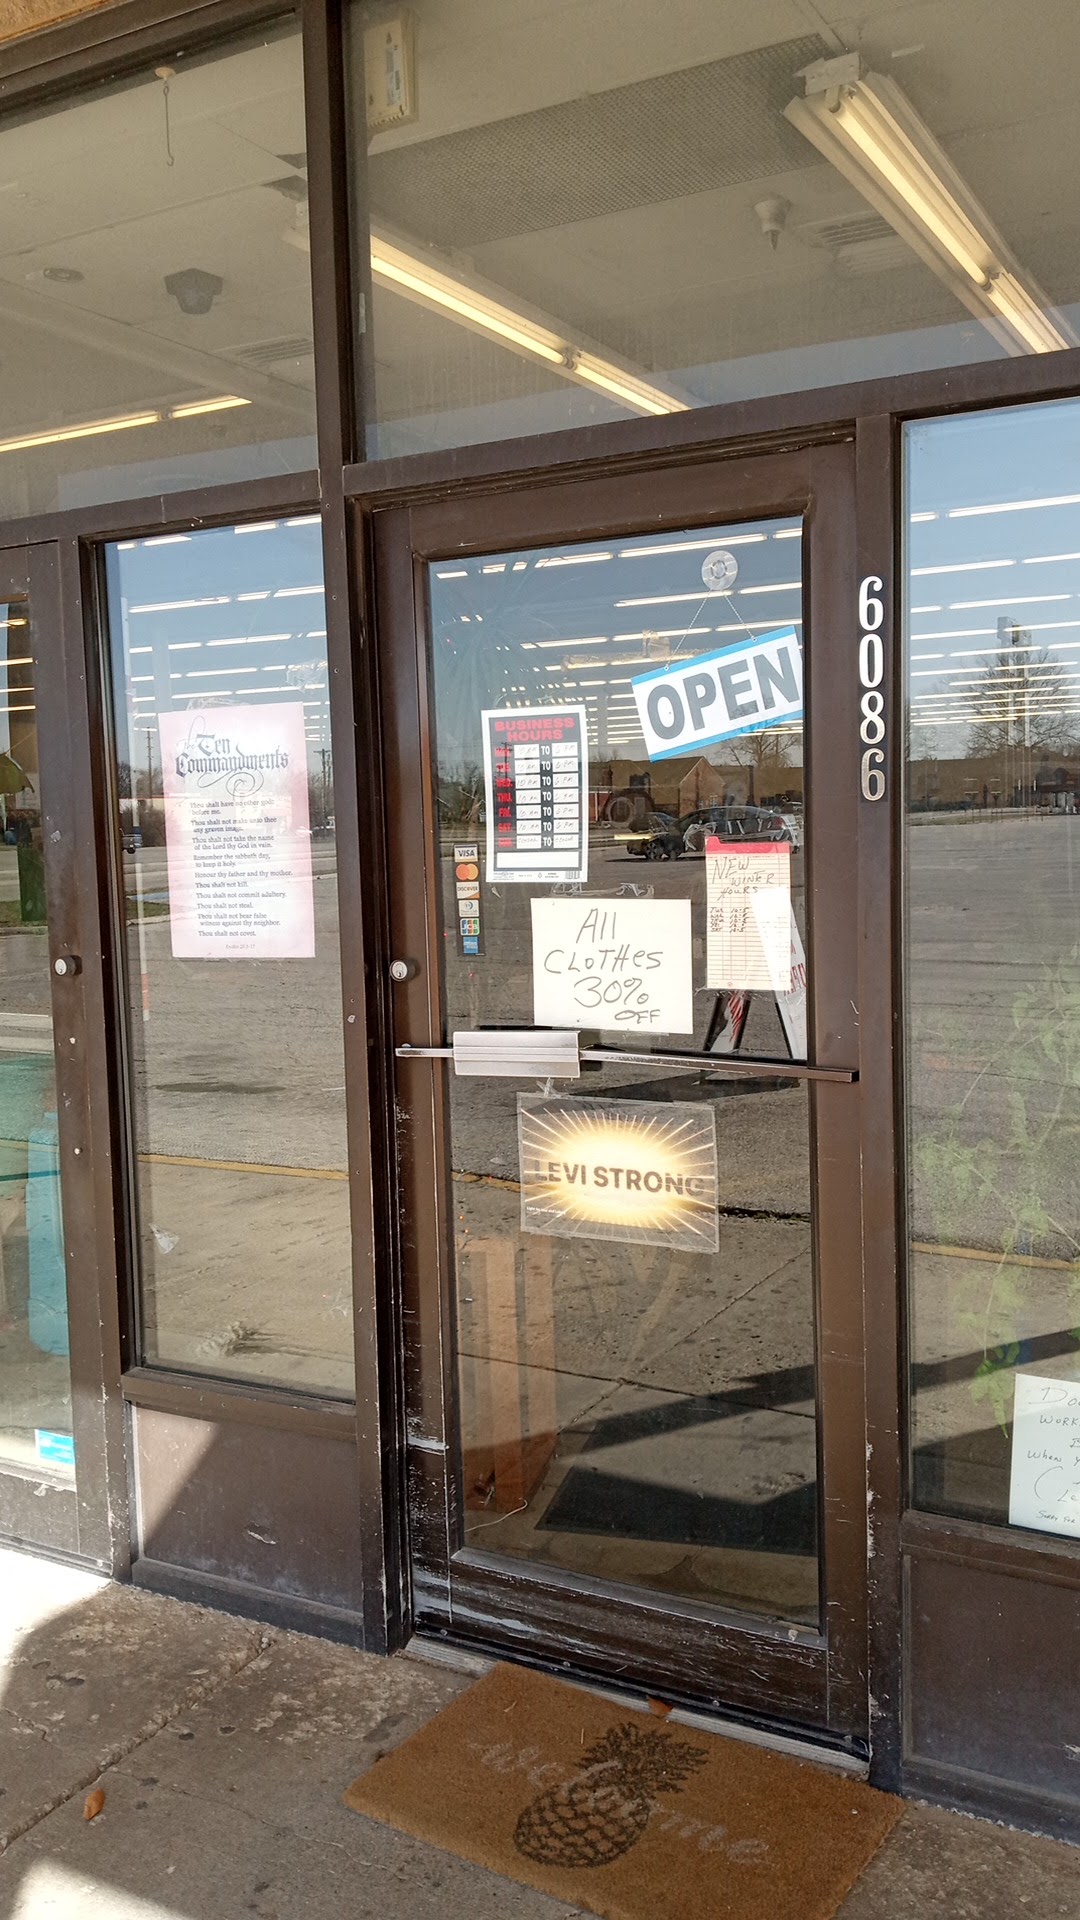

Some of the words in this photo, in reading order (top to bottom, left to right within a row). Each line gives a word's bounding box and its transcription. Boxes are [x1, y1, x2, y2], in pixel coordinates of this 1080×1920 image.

[647, 646, 800, 740] OPEN
[859, 576, 885, 801] 6086
[495, 717, 575, 732] BUSINESS
[507, 729, 563, 742] HOURS
[197, 734, 230, 756] Ten
[540, 745, 550, 756] TO
[175, 744, 289, 778] Commandments
[541, 761, 551, 771] TO
[542, 777, 551, 786] TO
[542, 792, 552, 801] TO
[543, 807, 552, 817] TO
[543, 822, 552, 832] TO
[543, 837, 553, 847] TO
[458, 849, 475, 857] VISA
[259, 870, 269, 878] thy
[711, 856, 750, 884] NEW
[253, 919, 281, 927] neighbor.
[573, 976, 649, 1008] 30%
[614, 1009, 661, 1024] OFF
[534, 1160, 587, 1185] LEVI
[593, 1165, 705, 1197] STRONG
[1028, 1386, 1080, 1406] Do
